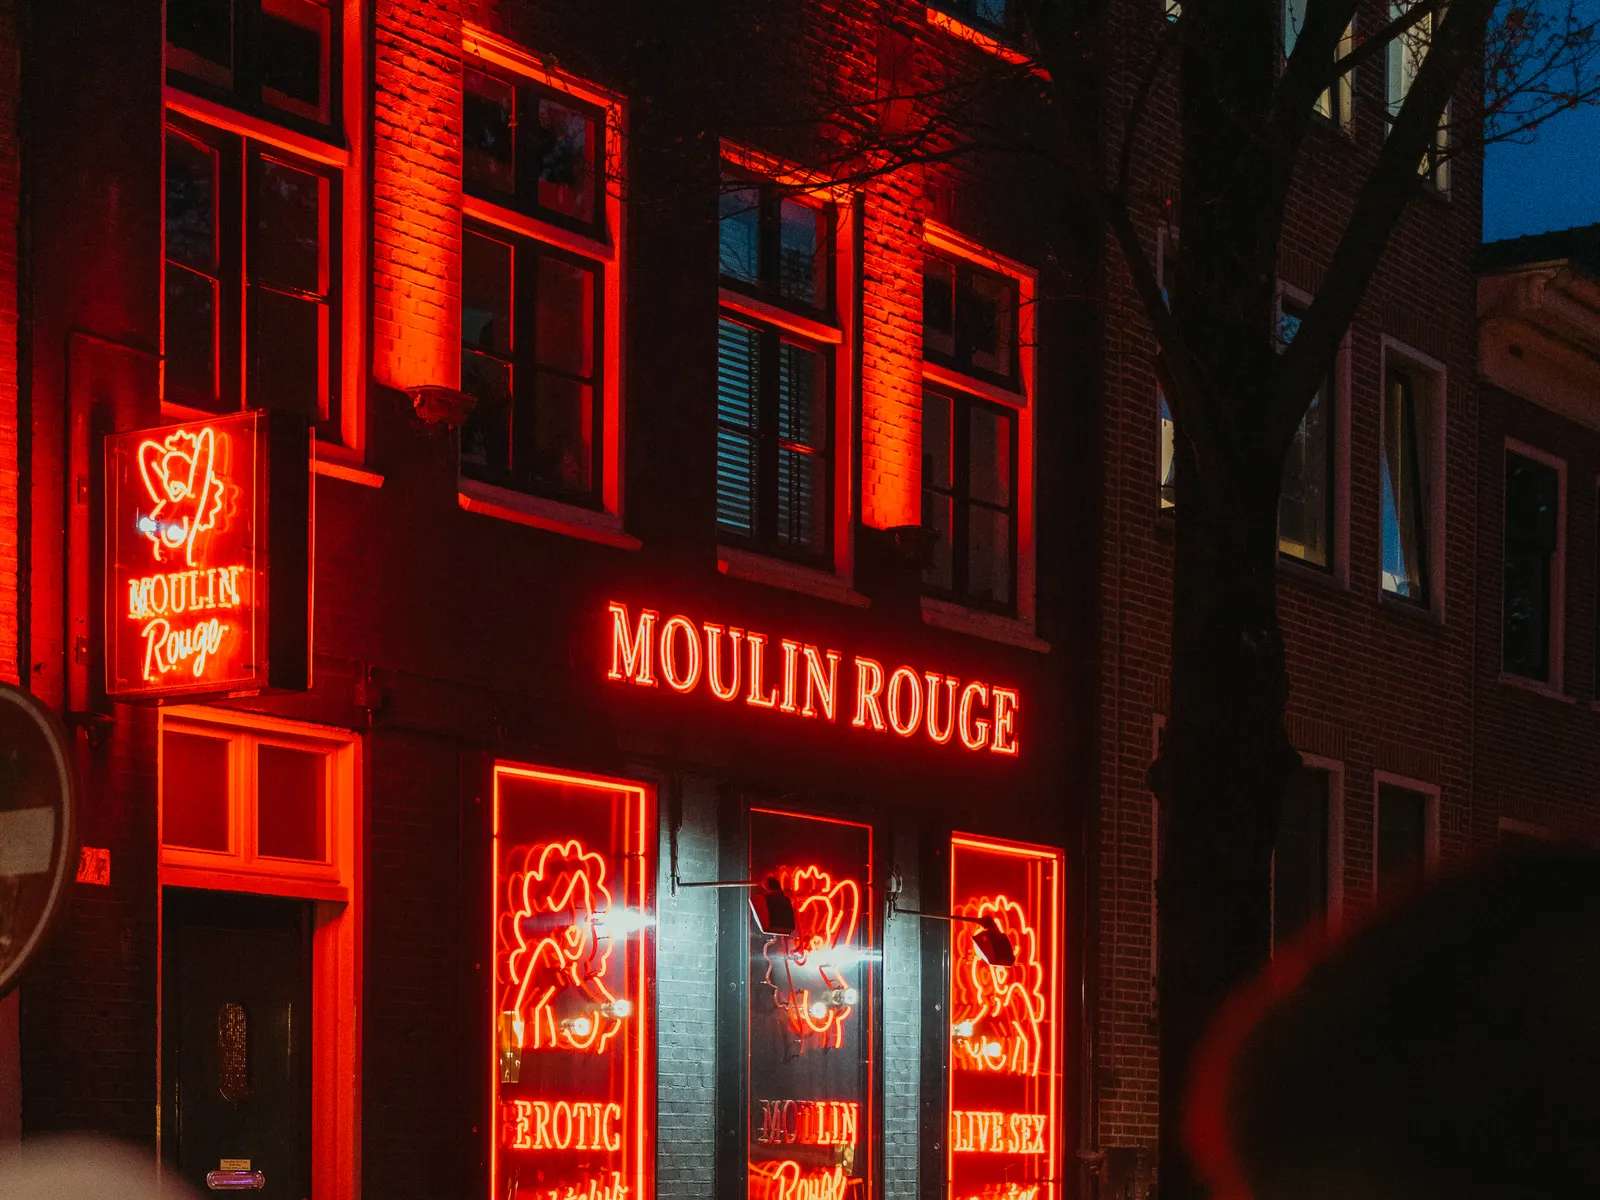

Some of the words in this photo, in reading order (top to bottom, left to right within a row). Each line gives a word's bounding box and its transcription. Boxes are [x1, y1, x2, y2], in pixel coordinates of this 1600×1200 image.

[128, 566, 243, 619] MOULIN
[141, 618, 229, 680] Rouge
[608, 600, 842, 724] MOULIN
[852, 654, 1020, 756] ROUGE
[513, 1100, 621, 1151] EROTIC
[757, 1099, 858, 1144] MOULIN
[953, 1110, 1004, 1152] LIVE
[1008, 1112, 1046, 1154] SEX
